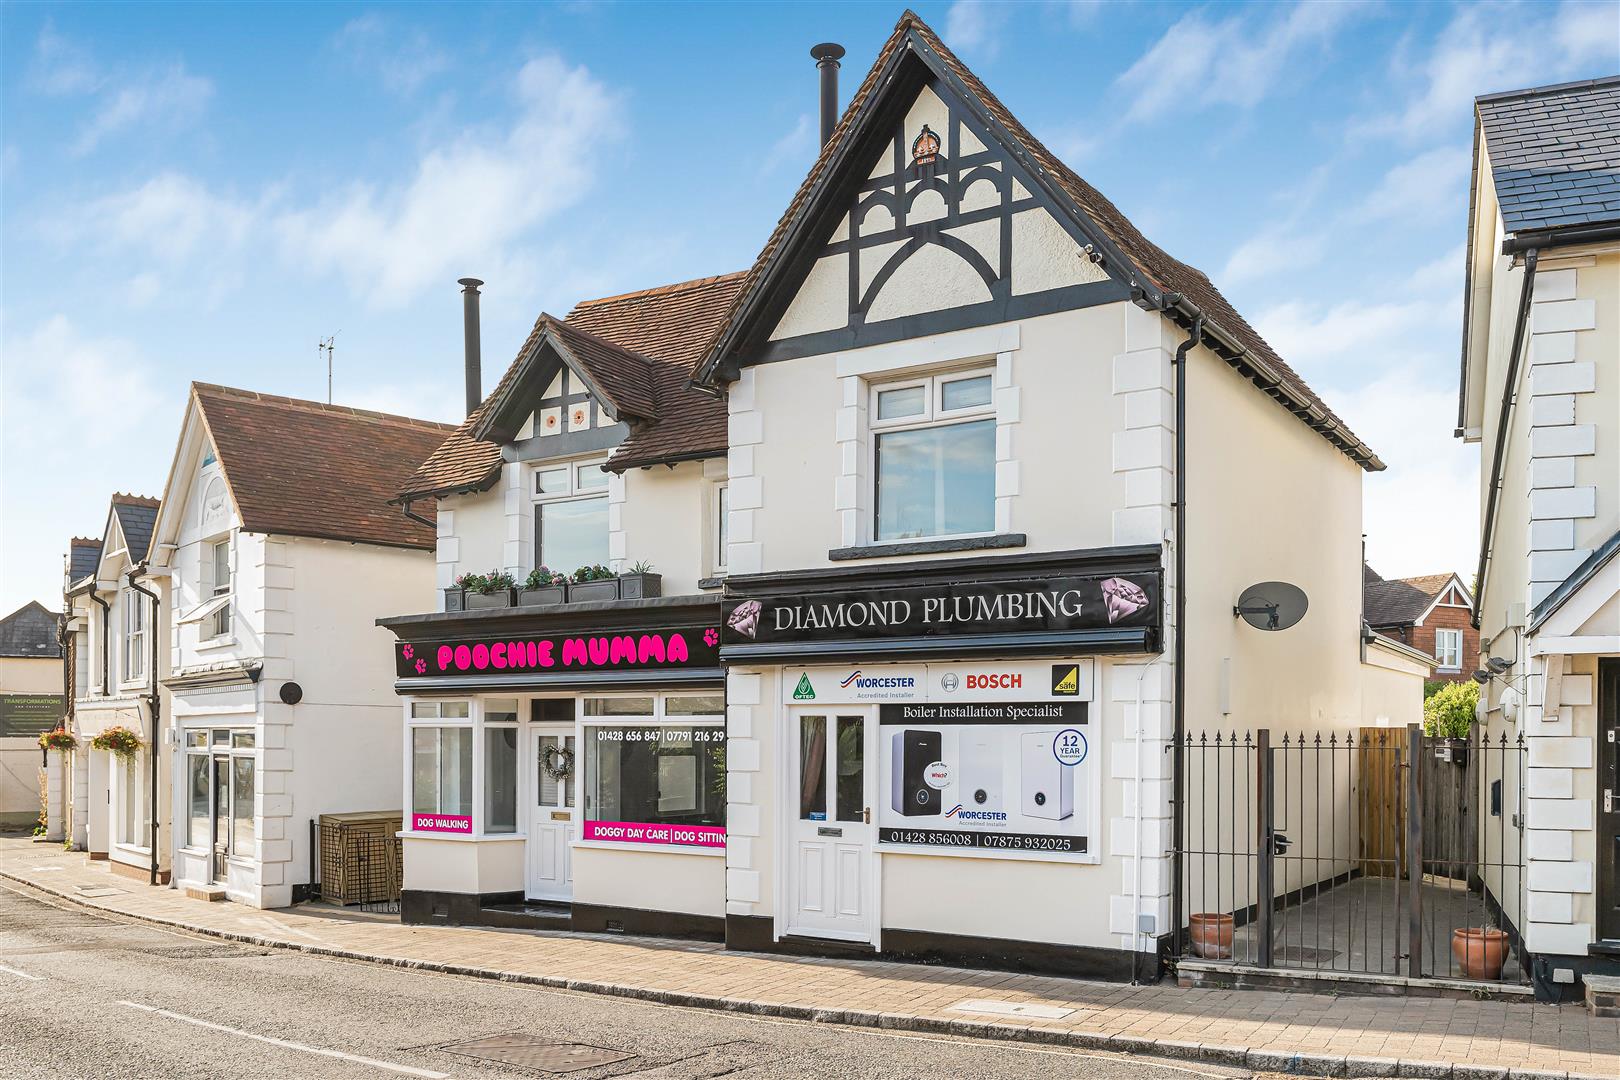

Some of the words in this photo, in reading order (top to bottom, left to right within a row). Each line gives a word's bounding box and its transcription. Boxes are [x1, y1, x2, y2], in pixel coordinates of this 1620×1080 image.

[774, 600, 911, 631] DIAMOND
[922, 589, 1084, 623] PLUMBING
[437, 640, 554, 671] POOCHIE
[562, 633, 689, 666] MUMMA
[856, 677, 915, 689] WORCESTER
[966, 673, 1022, 690] BOSCH
[903, 706, 936, 719] Boiler
[939, 706, 1002, 719] Installation
[1006, 704, 1063, 720] Specialist
[597, 730, 623, 741] 01428
[625, 730, 642, 741] 656
[644, 730, 661, 741] 847
[666, 730, 692, 741] 07791
[694, 730, 710, 741] 216
[712, 730, 725, 741] 29
[1063, 735, 1078, 747] 12
[417, 818, 434, 827] DOG
[435, 819, 469, 829] WALKING
[958, 811, 1007, 820] WORCESTER
[594, 826, 625, 837] DOGGY
[627, 828, 644, 838] DAY
[646, 828, 669, 840] CARE
[674, 831, 695, 842] DOG
[697, 832, 726, 843] SITTIN
[891, 831, 926, 844] 01428
[928, 834, 972, 846] 856008
[984, 835, 1022, 849] 07875
[1024, 837, 1071, 851] 932025
